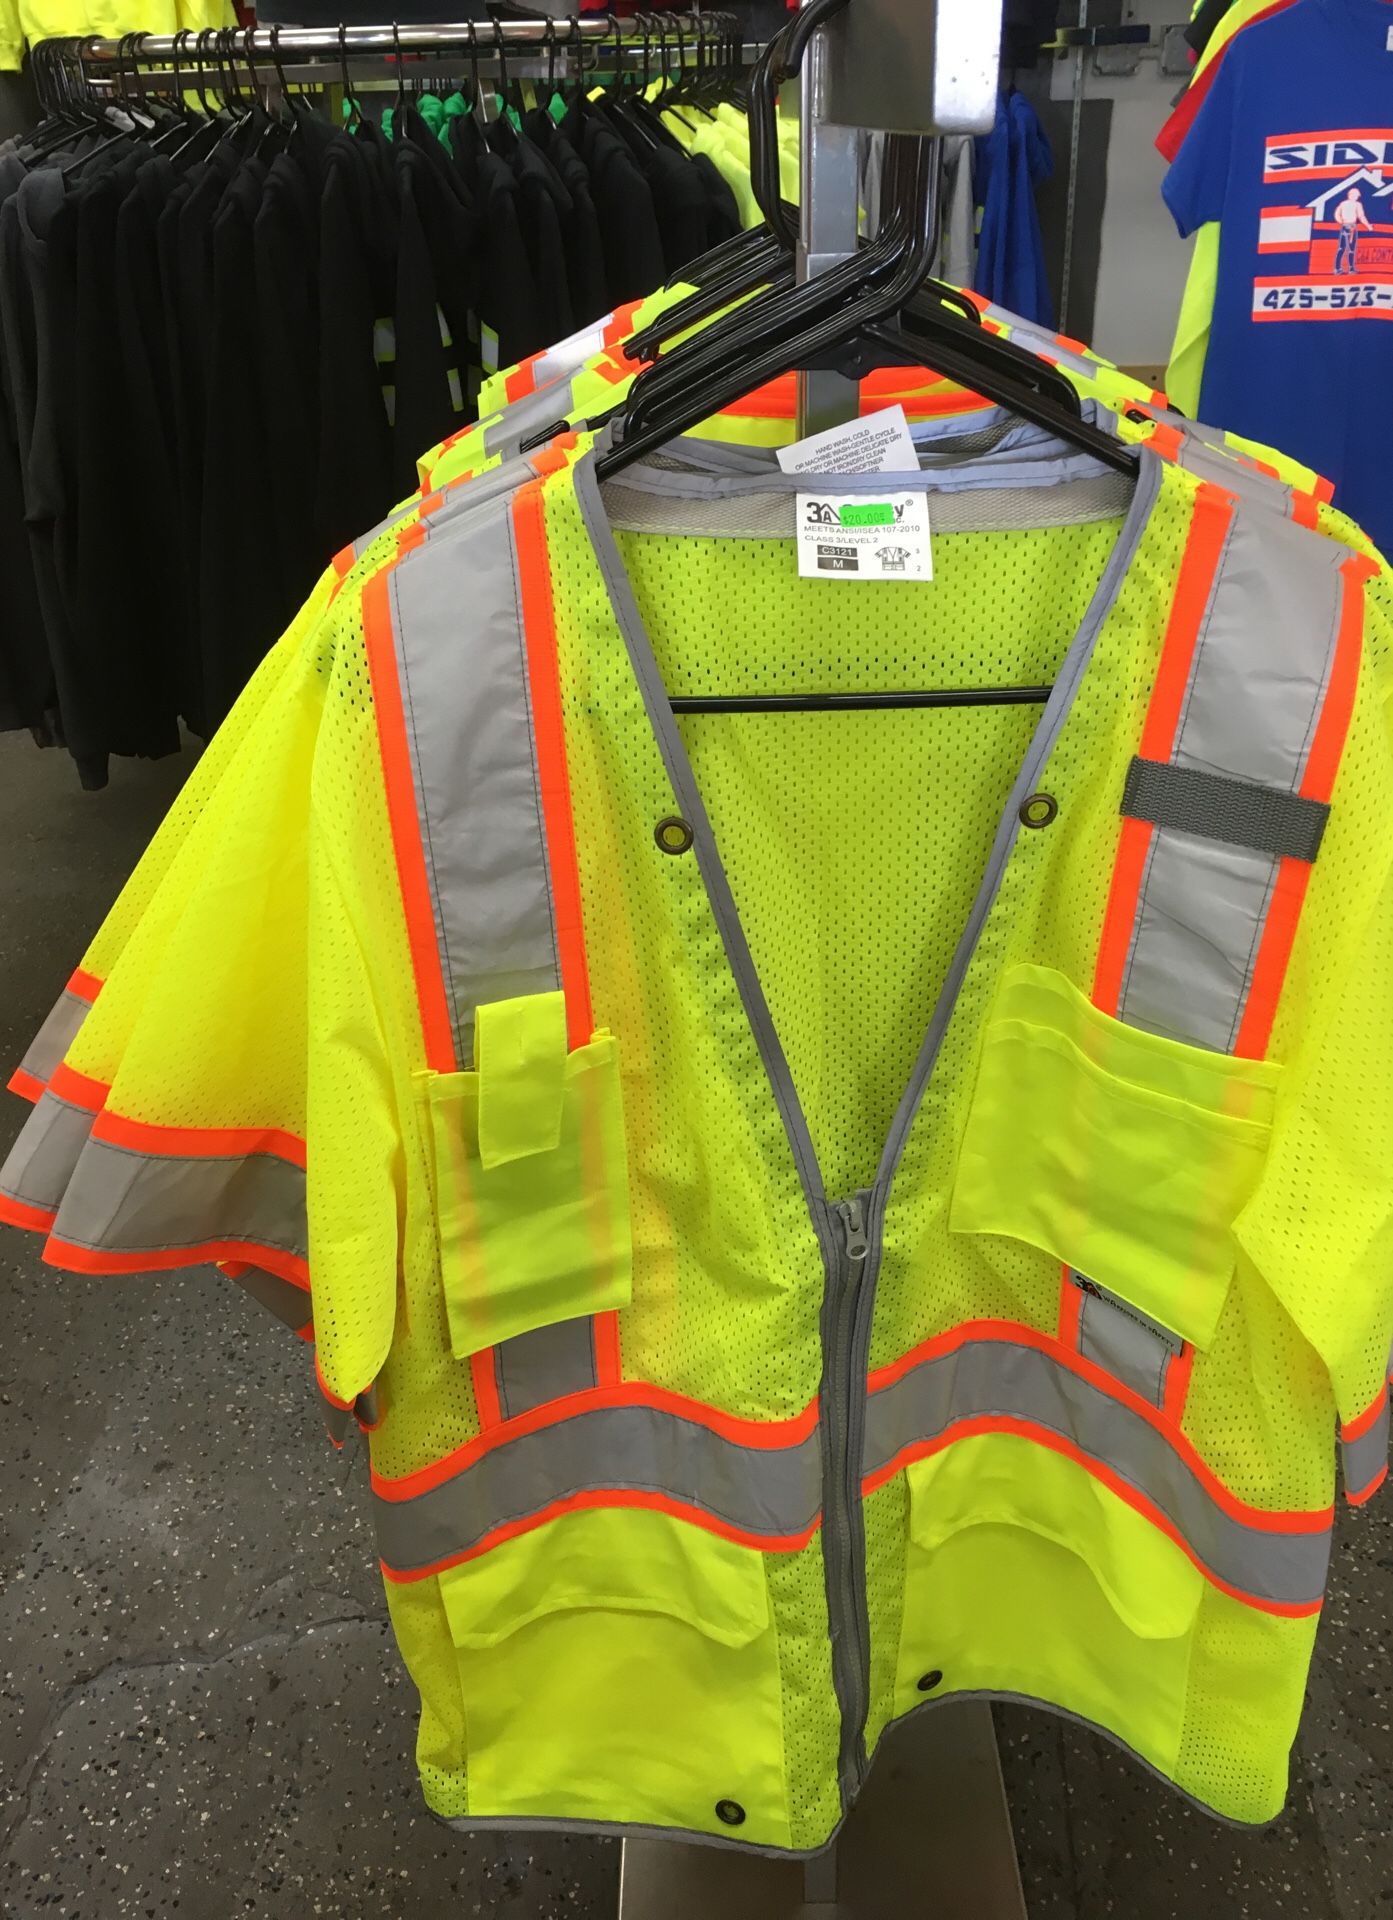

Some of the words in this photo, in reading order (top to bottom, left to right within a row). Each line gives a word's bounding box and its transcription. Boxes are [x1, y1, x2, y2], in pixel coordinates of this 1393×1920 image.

[1262, 285, 1393, 310] 425-523-
[794, 462, 805, 471] OR
[804, 450, 833, 467] MACHINE
[832, 436, 875, 456] WASH-GENTLE
[875, 427, 896, 440] CYCLE
[810, 463, 823, 473] DRY
[823, 459, 833, 468] OR
[833, 448, 861, 465] MACHINE
[860, 438, 890, 454] DELICATE
[889, 432, 903, 443] DRY
[815, 443, 833, 456] HAND
[852, 429, 870, 440] COLD
[837, 455, 865, 471] IRON/DRY
[865, 447, 887, 460] CLEAN
[804, 525, 835, 533] MEETS
[835, 526, 881, 534] ANSI/ISEA
[882, 525, 921, 533] 107-2010
[804, 535, 834, 543] CLASS
[836, 536, 873, 544] 3/LEVEL
[821, 547, 852, 556] C3121
[832, 559, 844, 568] M
